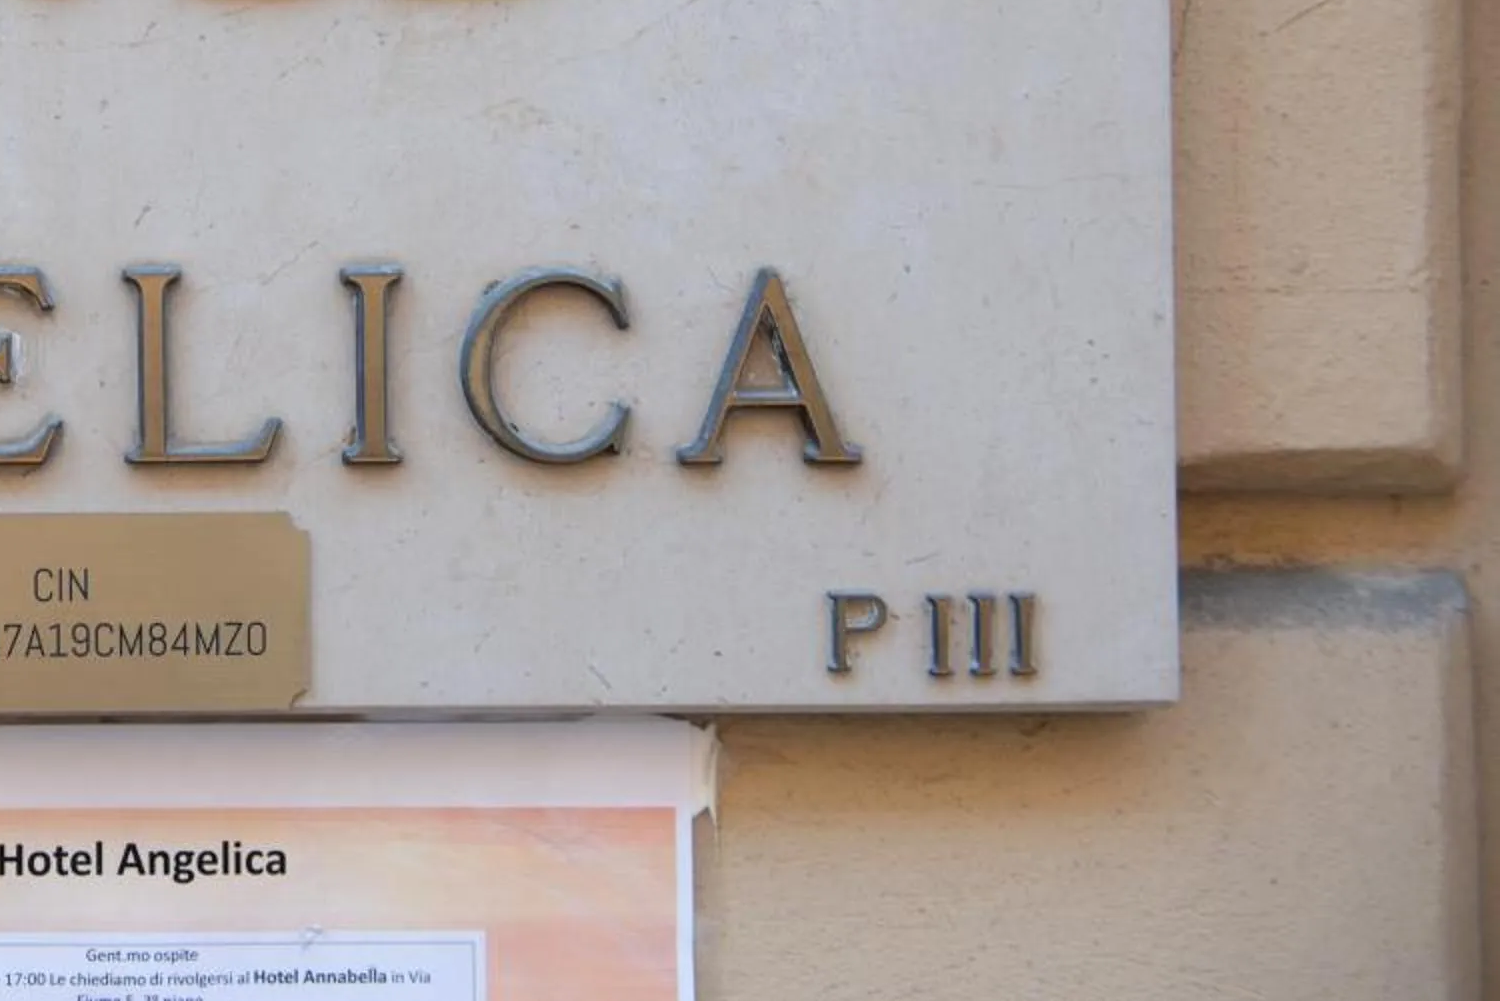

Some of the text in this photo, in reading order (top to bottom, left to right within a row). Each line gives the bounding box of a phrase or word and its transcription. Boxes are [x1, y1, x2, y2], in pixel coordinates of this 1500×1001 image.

[33, 567, 89, 602] CIN
[117, 841, 288, 884] Angelica
[85, 949, 199, 964] Gent.mo ospite
[5, 973, 46, 987] 17:00
[50, 973, 66, 986] Le
[69, 971, 147, 986] chiediamo
[150, 971, 163, 985] di
[167, 970, 233, 988] rivolgersi
[237, 970, 250, 985] al
[253, 970, 299, 984] Hotel
[303, 968, 387, 984] Annabella
[391, 969, 405, 984] in
[408, 969, 431, 984] Via
